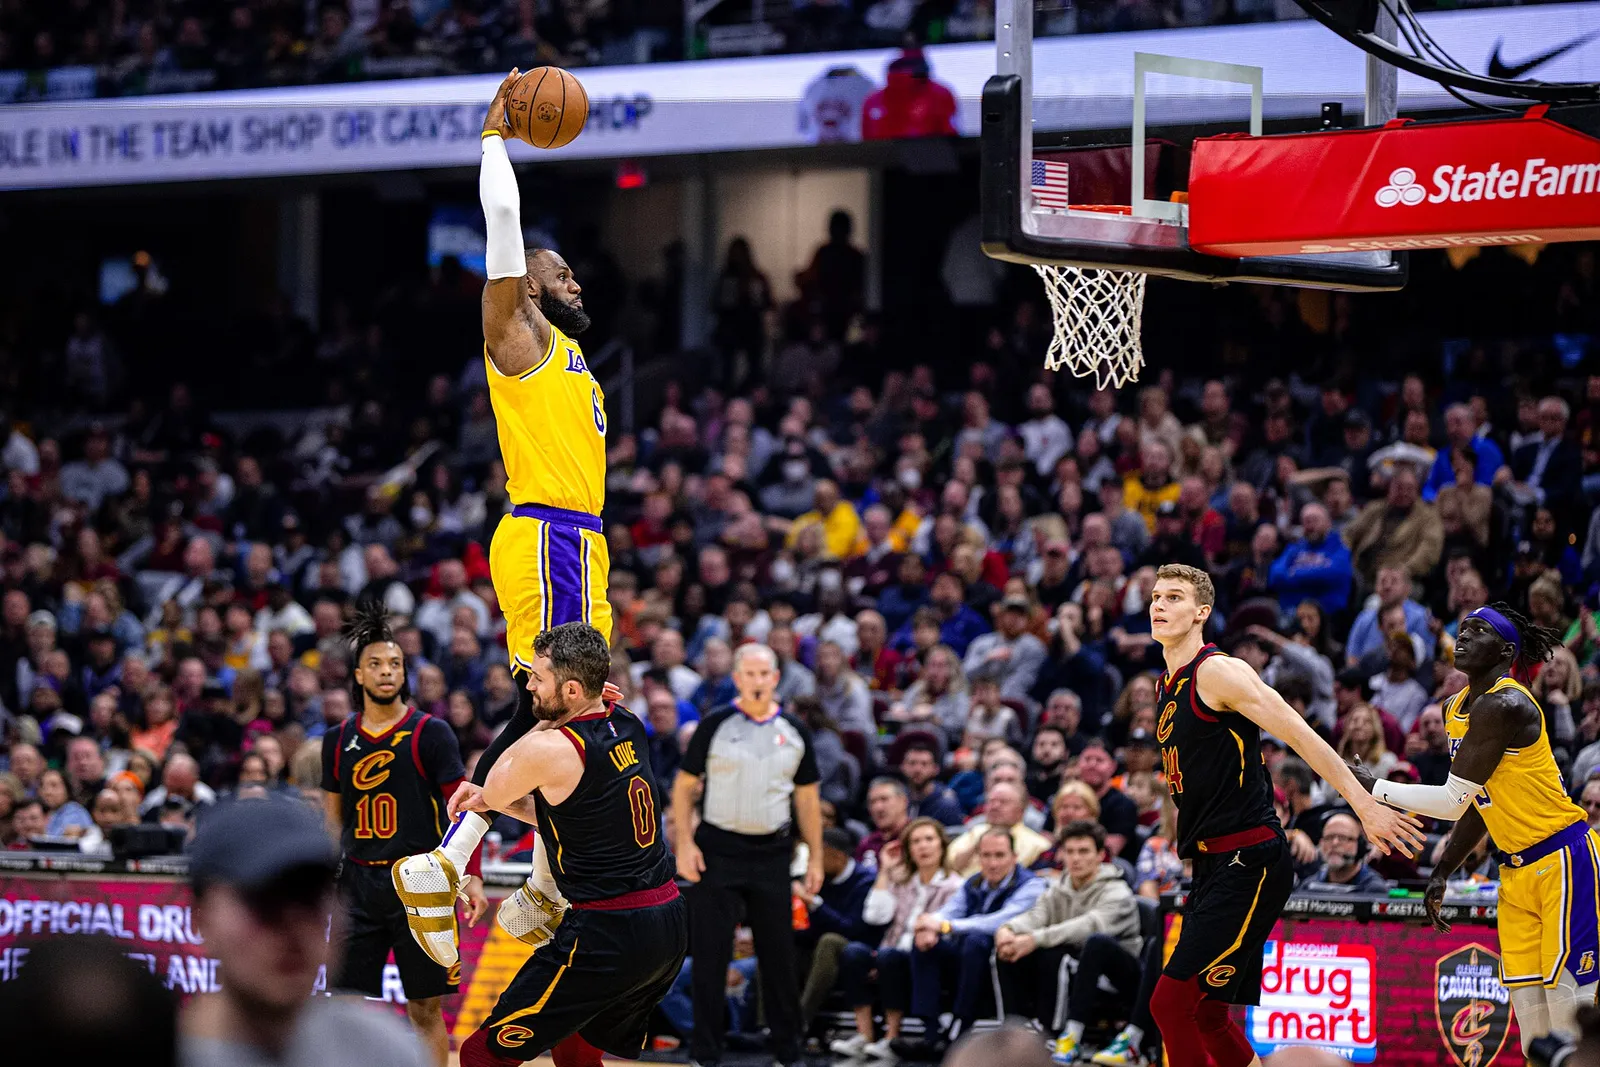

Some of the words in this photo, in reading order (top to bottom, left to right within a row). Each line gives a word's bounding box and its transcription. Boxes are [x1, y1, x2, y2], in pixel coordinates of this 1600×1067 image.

[87, 121, 143, 163] THE
[153, 117, 233, 159] TEAM
[241, 111, 324, 154] SHOP
[331, 108, 375, 148] OR
[591, 387, 607, 437] 6
[608, 741, 639, 772] LOVE
[355, 793, 398, 839] 10
[628, 775, 656, 848] 0
[0, 899, 135, 939] OFFICIAL
[1372, 901, 1413, 916] ROCKET
[1284, 943, 1338, 956] DISCOUNT
[1261, 941, 1352, 1009] drug
[1455, 964, 1493, 977] CLEVELAND
[1267, 1008, 1374, 1044] mart
